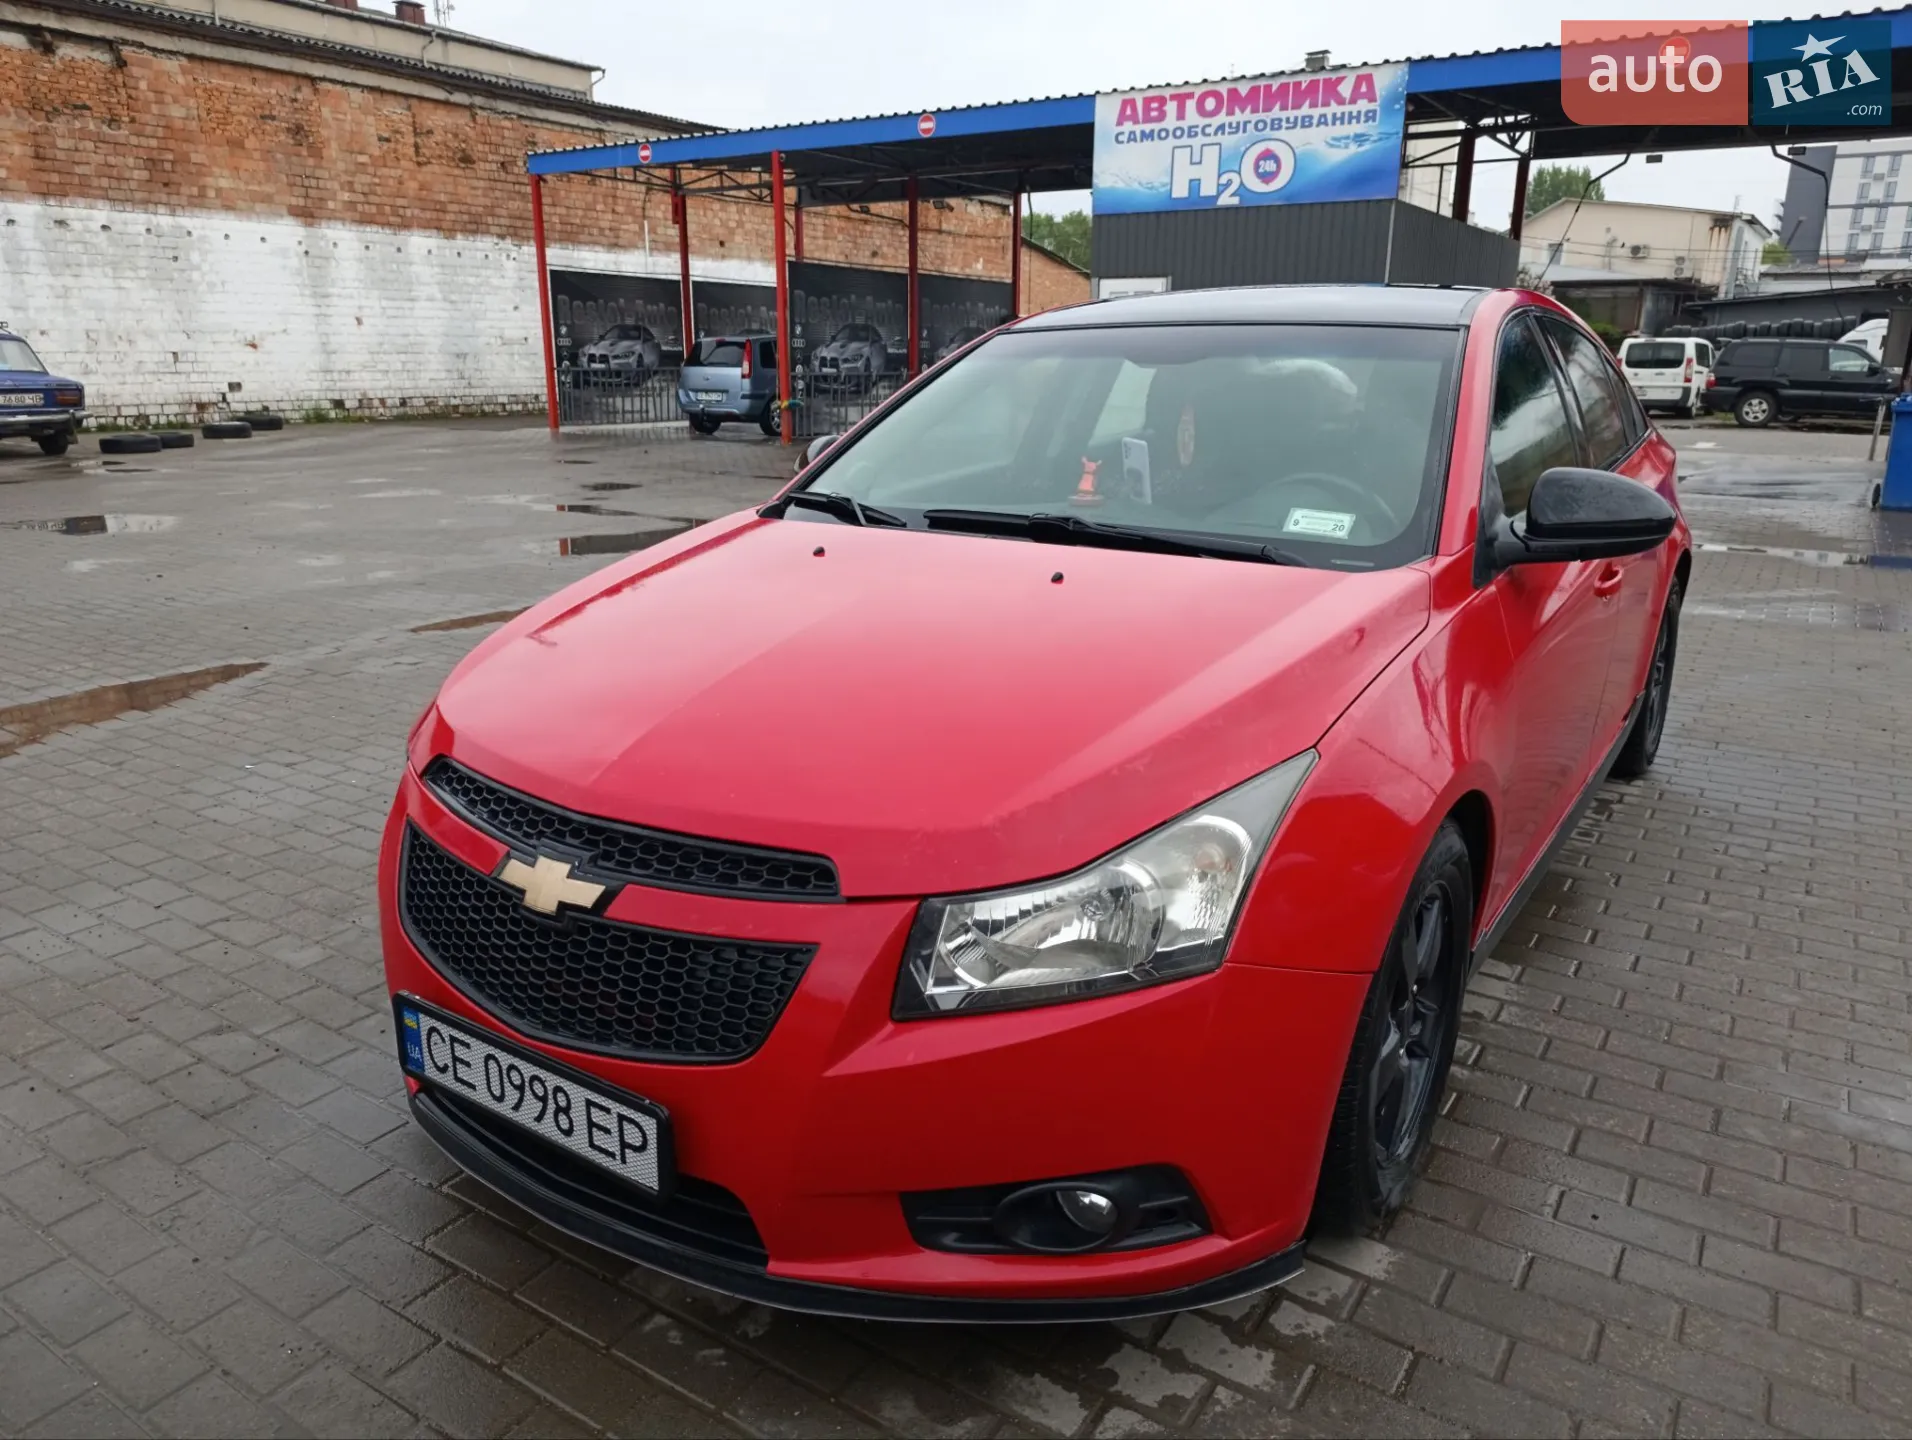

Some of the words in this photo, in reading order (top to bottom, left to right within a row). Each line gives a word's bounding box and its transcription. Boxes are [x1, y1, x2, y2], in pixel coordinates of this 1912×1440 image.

[1114, 109, 1377, 144] САМООБСЛУГОВУВАННЯ
[1332, 524, 1345, 532] 20
[426, 1026, 477, 1091] CE
[484, 1053, 575, 1138] 0998
[585, 1097, 649, 1166] EP
